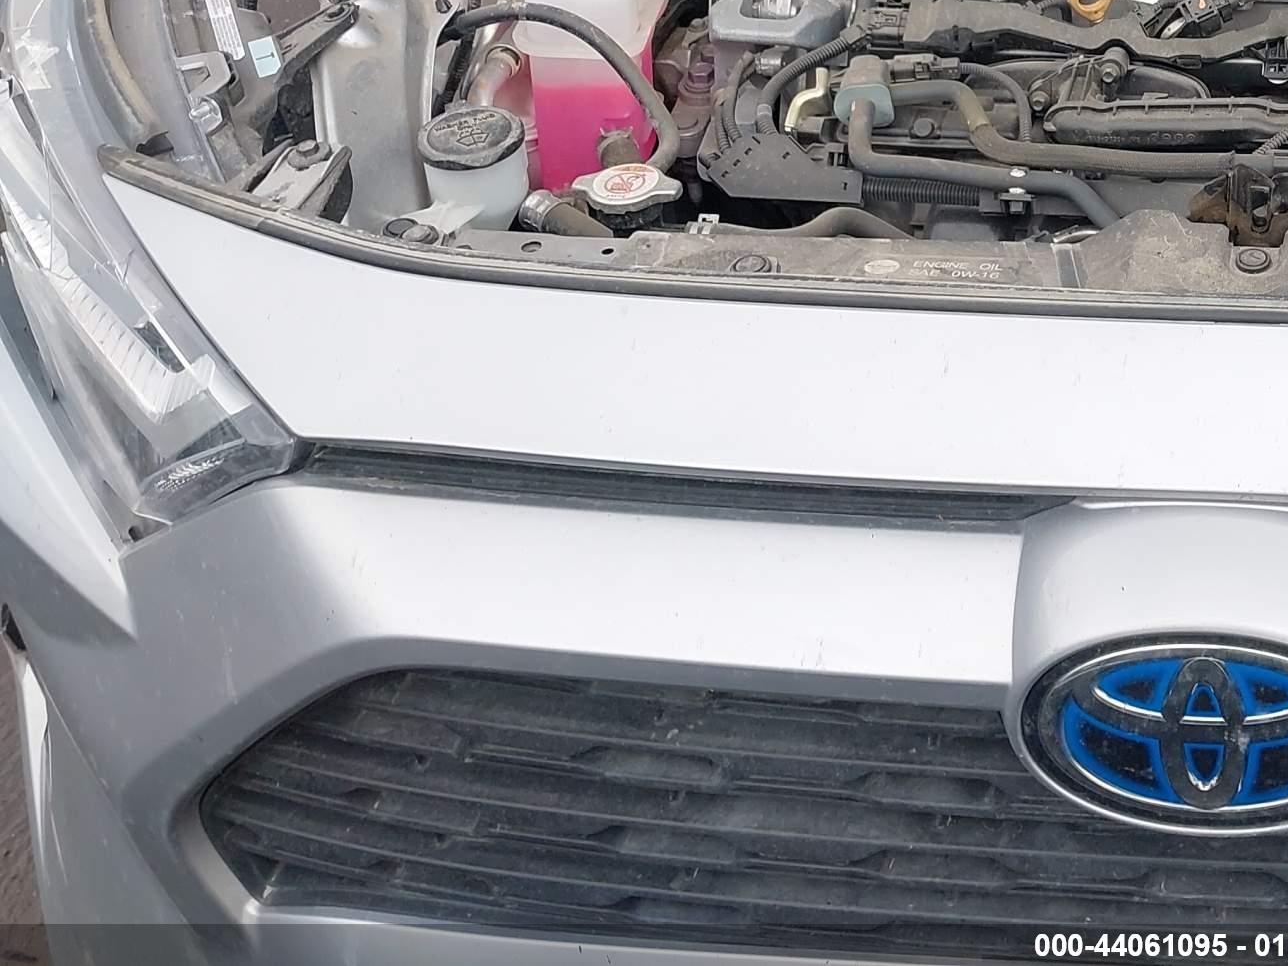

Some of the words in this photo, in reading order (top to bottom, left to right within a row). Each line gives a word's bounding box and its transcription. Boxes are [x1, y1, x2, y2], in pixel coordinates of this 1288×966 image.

[433, 119, 470, 133] WASHER
[472, 113, 496, 124] FLUID
[912, 260, 970, 271] ENGINE
[979, 262, 1004, 272] OIL
[907, 268, 941, 278] SAE
